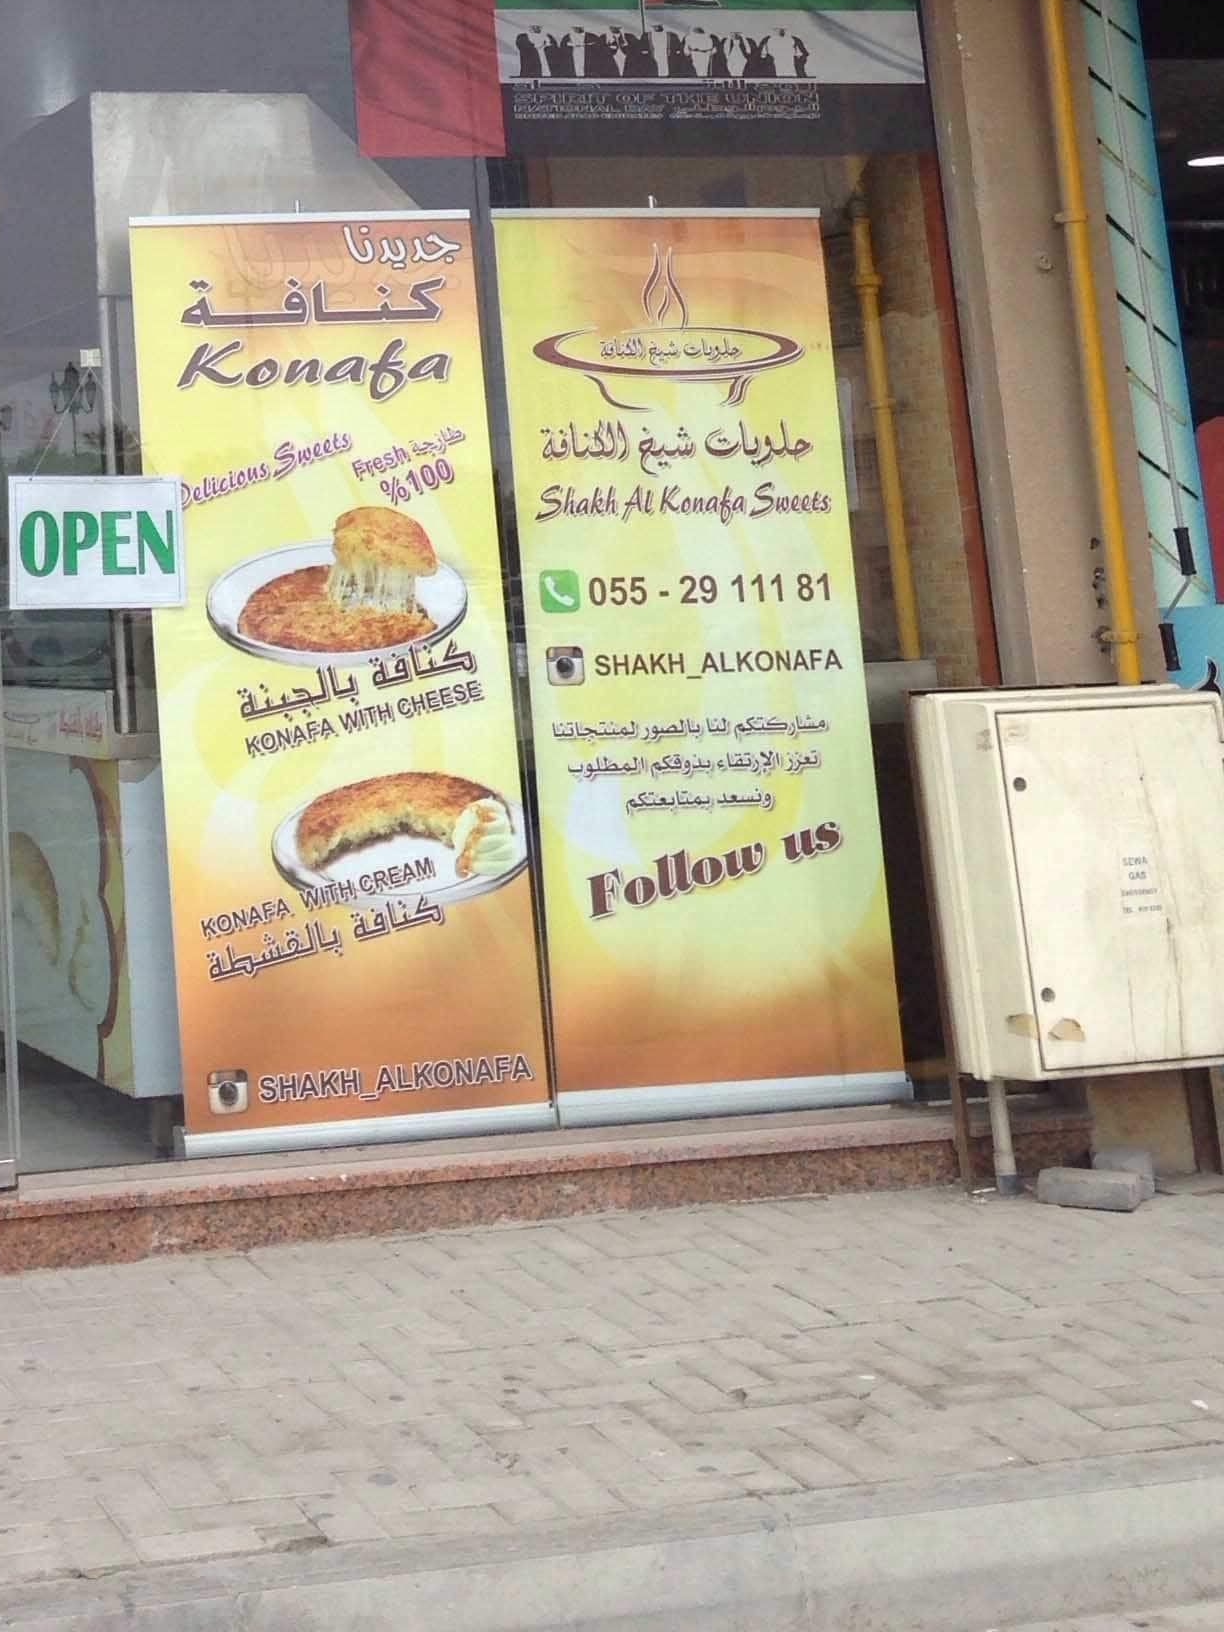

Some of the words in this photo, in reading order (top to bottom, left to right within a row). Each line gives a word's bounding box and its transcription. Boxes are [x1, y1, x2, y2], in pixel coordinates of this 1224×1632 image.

[343, 224, 462, 268] جديدنا
[176, 337, 452, 402] Konafa
[647, 339, 681, 366] شيخ
[683, 338, 742, 362] حلويات
[272, 431, 351, 480] Sweets
[351, 445, 410, 481] Fresh
[409, 426, 465, 456] طازجة
[539, 418, 628, 461] الكنافة
[637, 426, 695, 478] شيخ
[704, 419, 812, 466] حلويات
[534, 485, 618, 521] Shakh
[622, 485, 653, 521] Al
[659, 484, 746, 526] Konafa
[748, 481, 832, 518] Sweets
[19, 509, 176, 577] OPEN
[587, 576, 649, 607] 055
[678, 573, 719, 605] 29
[729, 572, 785, 603] 111
[796, 571, 832, 603] 81
[368, 639, 477, 689] كنافة
[593, 648, 844, 680] SHAKH_ALKONAFA
[235, 663, 359, 723] بالجبنة
[244, 717, 337, 758] KONAFA
[339, 701, 394, 735] WITH
[396, 679, 486, 720] CHEESE
[551, 721, 639, 744] لمنتجاتنا
[643, 718, 702, 742] بالصور
[705, 717, 729, 734] لنا
[733, 715, 830, 739] مشاركتكم
[566, 756, 647, 780] المطلوب
[649, 752, 712, 777] بذوقكم
[785, 749, 822, 773] تعزز
[624, 789, 713, 816] بمتابعتكم
[716, 788, 775, 811] ونسعد
[586, 839, 767, 920] Follow
[780, 820, 846, 863] us
[200, 896, 292, 940] KONAFA
[299, 878, 355, 913] WITH
[358, 857, 436, 897] CREAM
[350, 893, 446, 942] كنافة
[205, 921, 343, 982] بالقشطة
[258, 1054, 536, 1105] SHAKH_ALKONAFA
